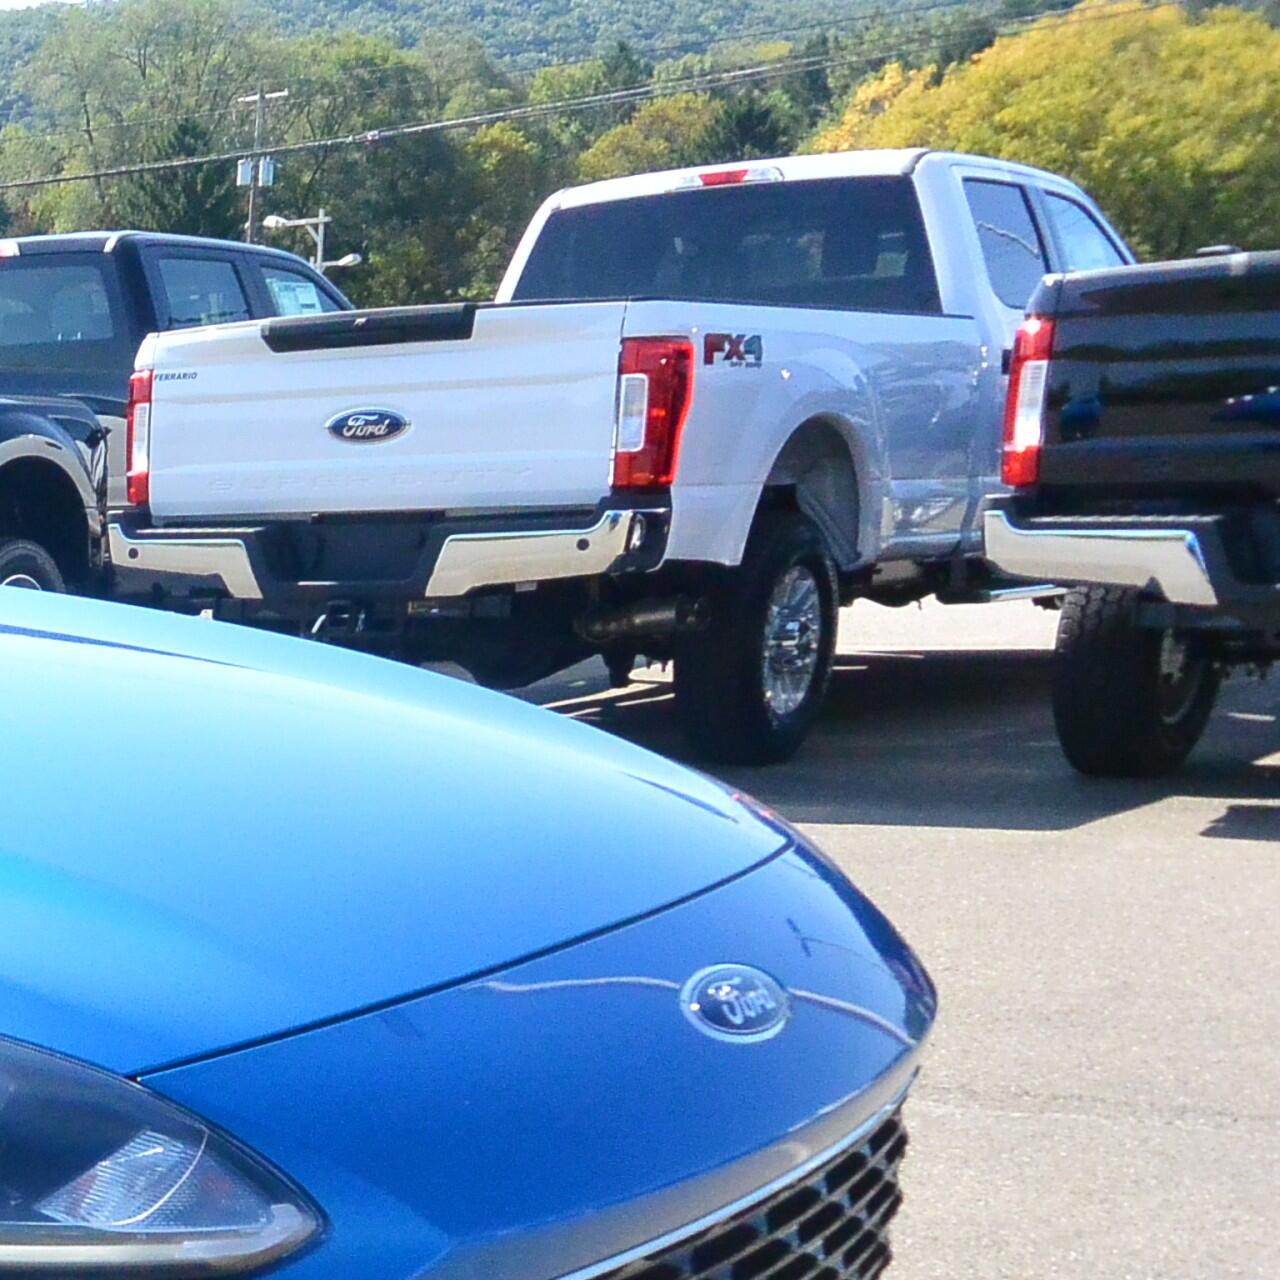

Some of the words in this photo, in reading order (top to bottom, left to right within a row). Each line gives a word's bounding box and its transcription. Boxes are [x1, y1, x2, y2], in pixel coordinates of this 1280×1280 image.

[703, 333, 763, 366] FX4
[343, 413, 391, 437] Ford
[706, 975, 777, 1025] Ford
